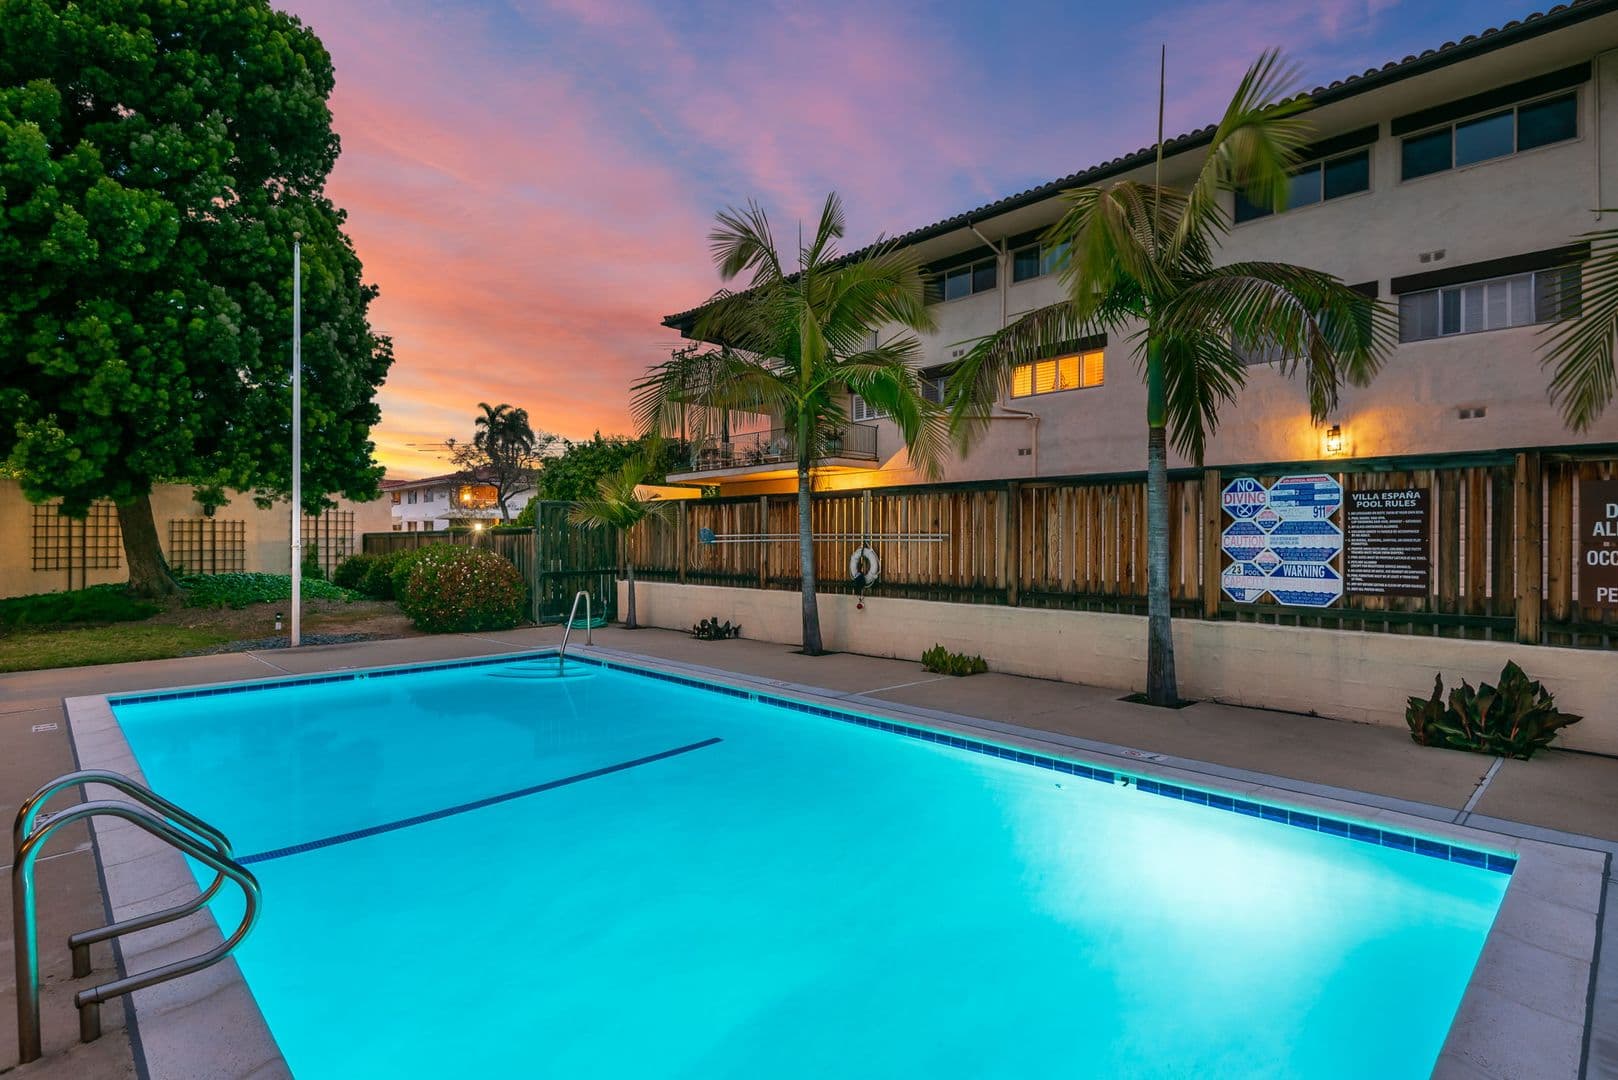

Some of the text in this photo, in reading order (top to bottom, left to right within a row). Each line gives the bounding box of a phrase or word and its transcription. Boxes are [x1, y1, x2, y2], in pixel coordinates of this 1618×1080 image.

[1237, 480, 1255, 492] NO
[1224, 492, 1266, 504] DIVING
[1352, 490, 1421, 501] VILLA ESPAÑA
[1313, 506, 1326, 518] 911
[1592, 521, 1618, 536] AL
[1223, 536, 1265, 547] CAUTION
[1231, 565, 1242, 574] 23
[1283, 565, 1325, 577] WARNING
